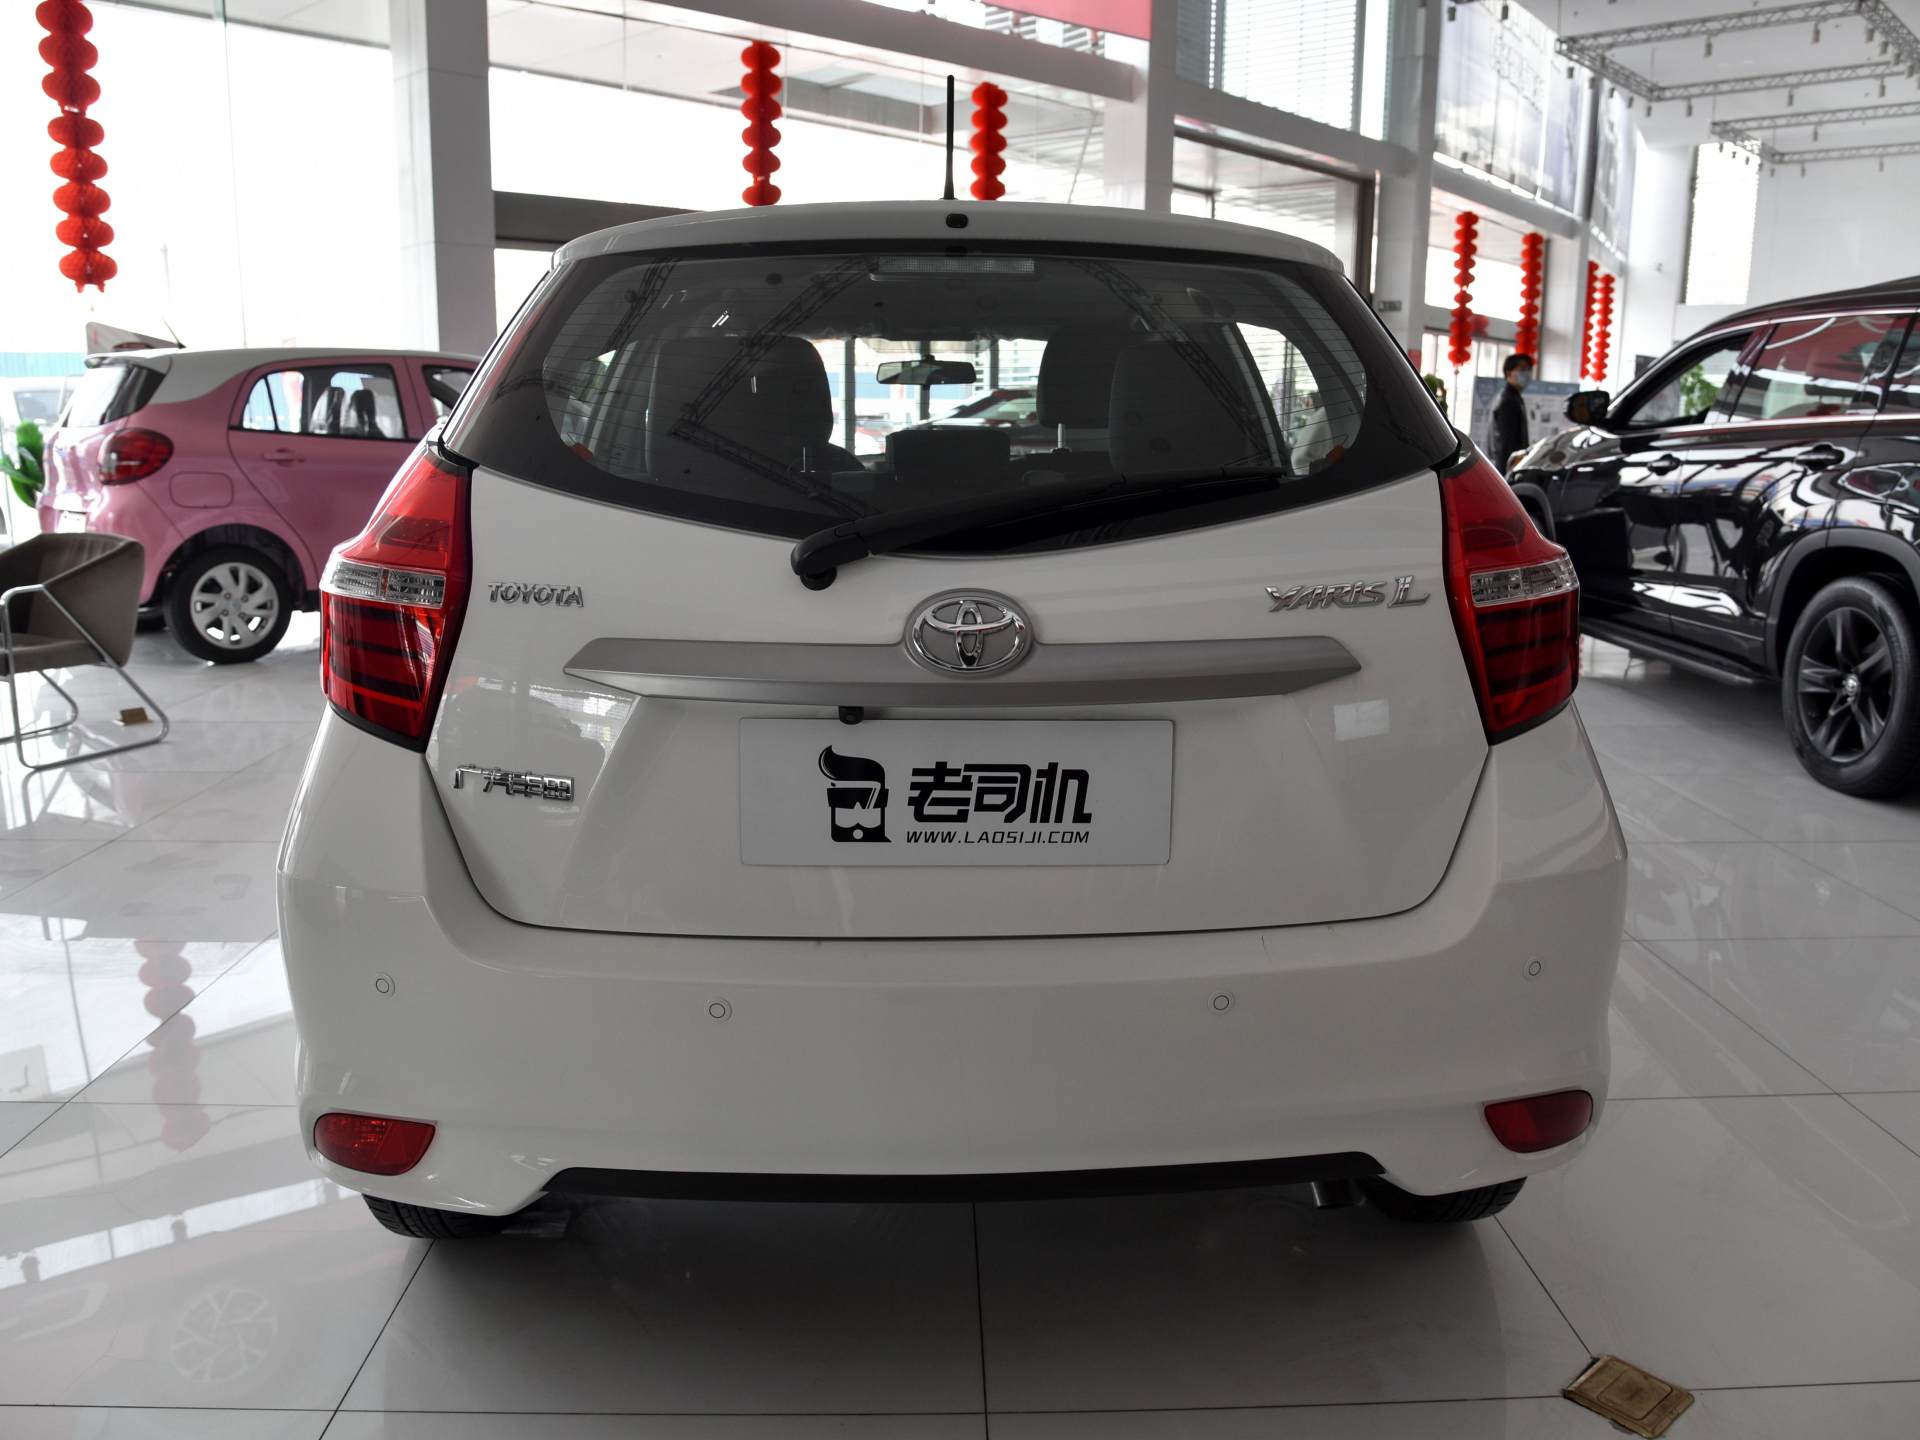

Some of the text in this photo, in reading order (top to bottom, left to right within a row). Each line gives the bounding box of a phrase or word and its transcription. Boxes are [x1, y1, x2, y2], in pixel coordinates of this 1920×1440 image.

[487, 582, 584, 608] TOYOTA
[1265, 581, 1388, 612] YARIS
[453, 765, 574, 801] 广汽丰田
[907, 761, 1093, 824] 老司机
[906, 831, 1090, 844] WWW.LAOSIJI.COM
